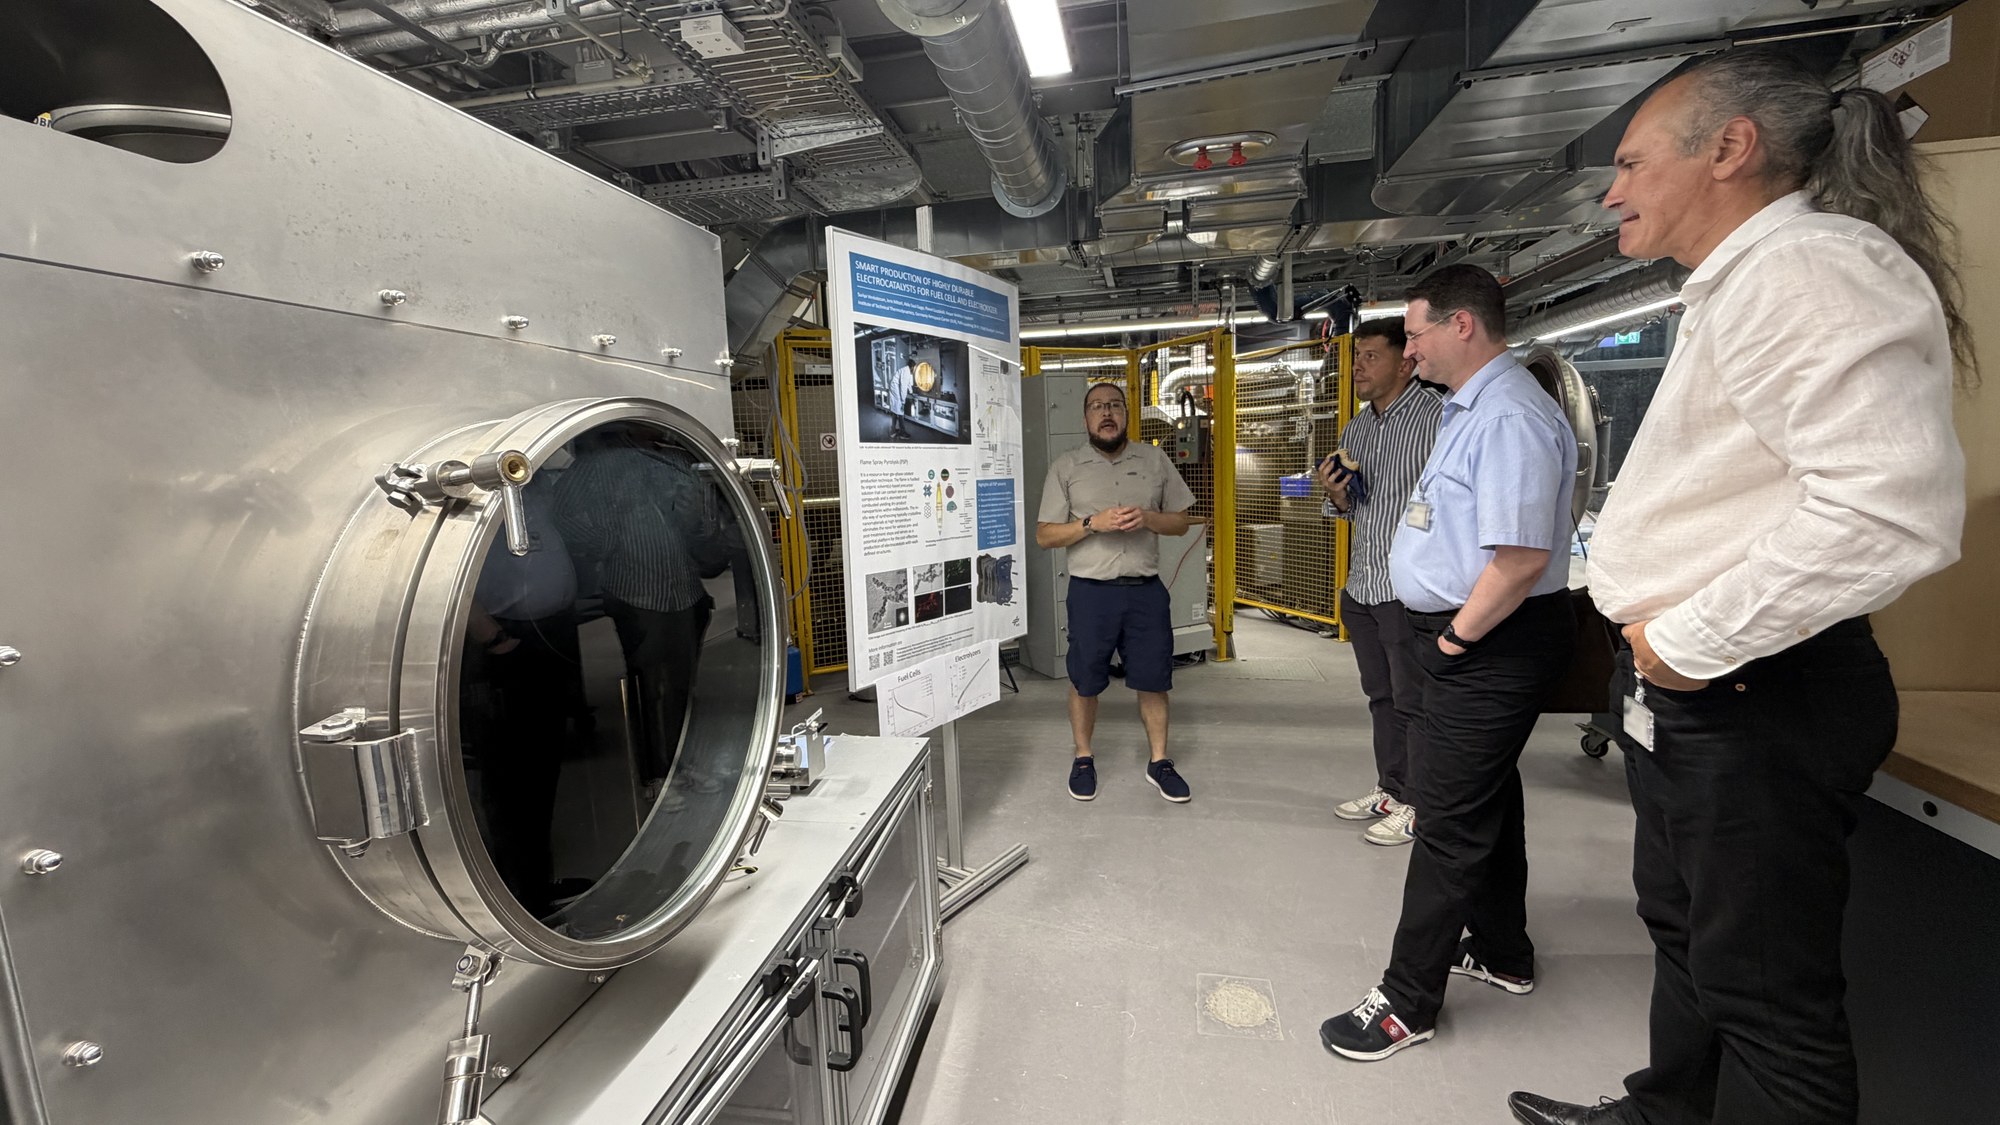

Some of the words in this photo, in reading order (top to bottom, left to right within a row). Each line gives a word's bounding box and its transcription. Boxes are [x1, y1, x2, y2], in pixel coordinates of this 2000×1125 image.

[855, 260, 879, 274] SMART
[880, 266, 922, 284] PRODUCTION
[922, 277, 931, 285] OF
[932, 279, 951, 291] HIGHLY
[952, 284, 974, 297] DURABLE
[856, 272, 916, 294] ELECTROCATALYSTS
[917, 287, 930, 297] FOR
[931, 290, 944, 300] FUEL
[944, 293, 957, 303] CELL
[957, 298, 967, 306] AND
[879, 642, 898, 650] information
[955, 649, 981, 663] Electrolyzers
[897, 673, 909, 682] Fuel
[909, 668, 921, 679] Cells
